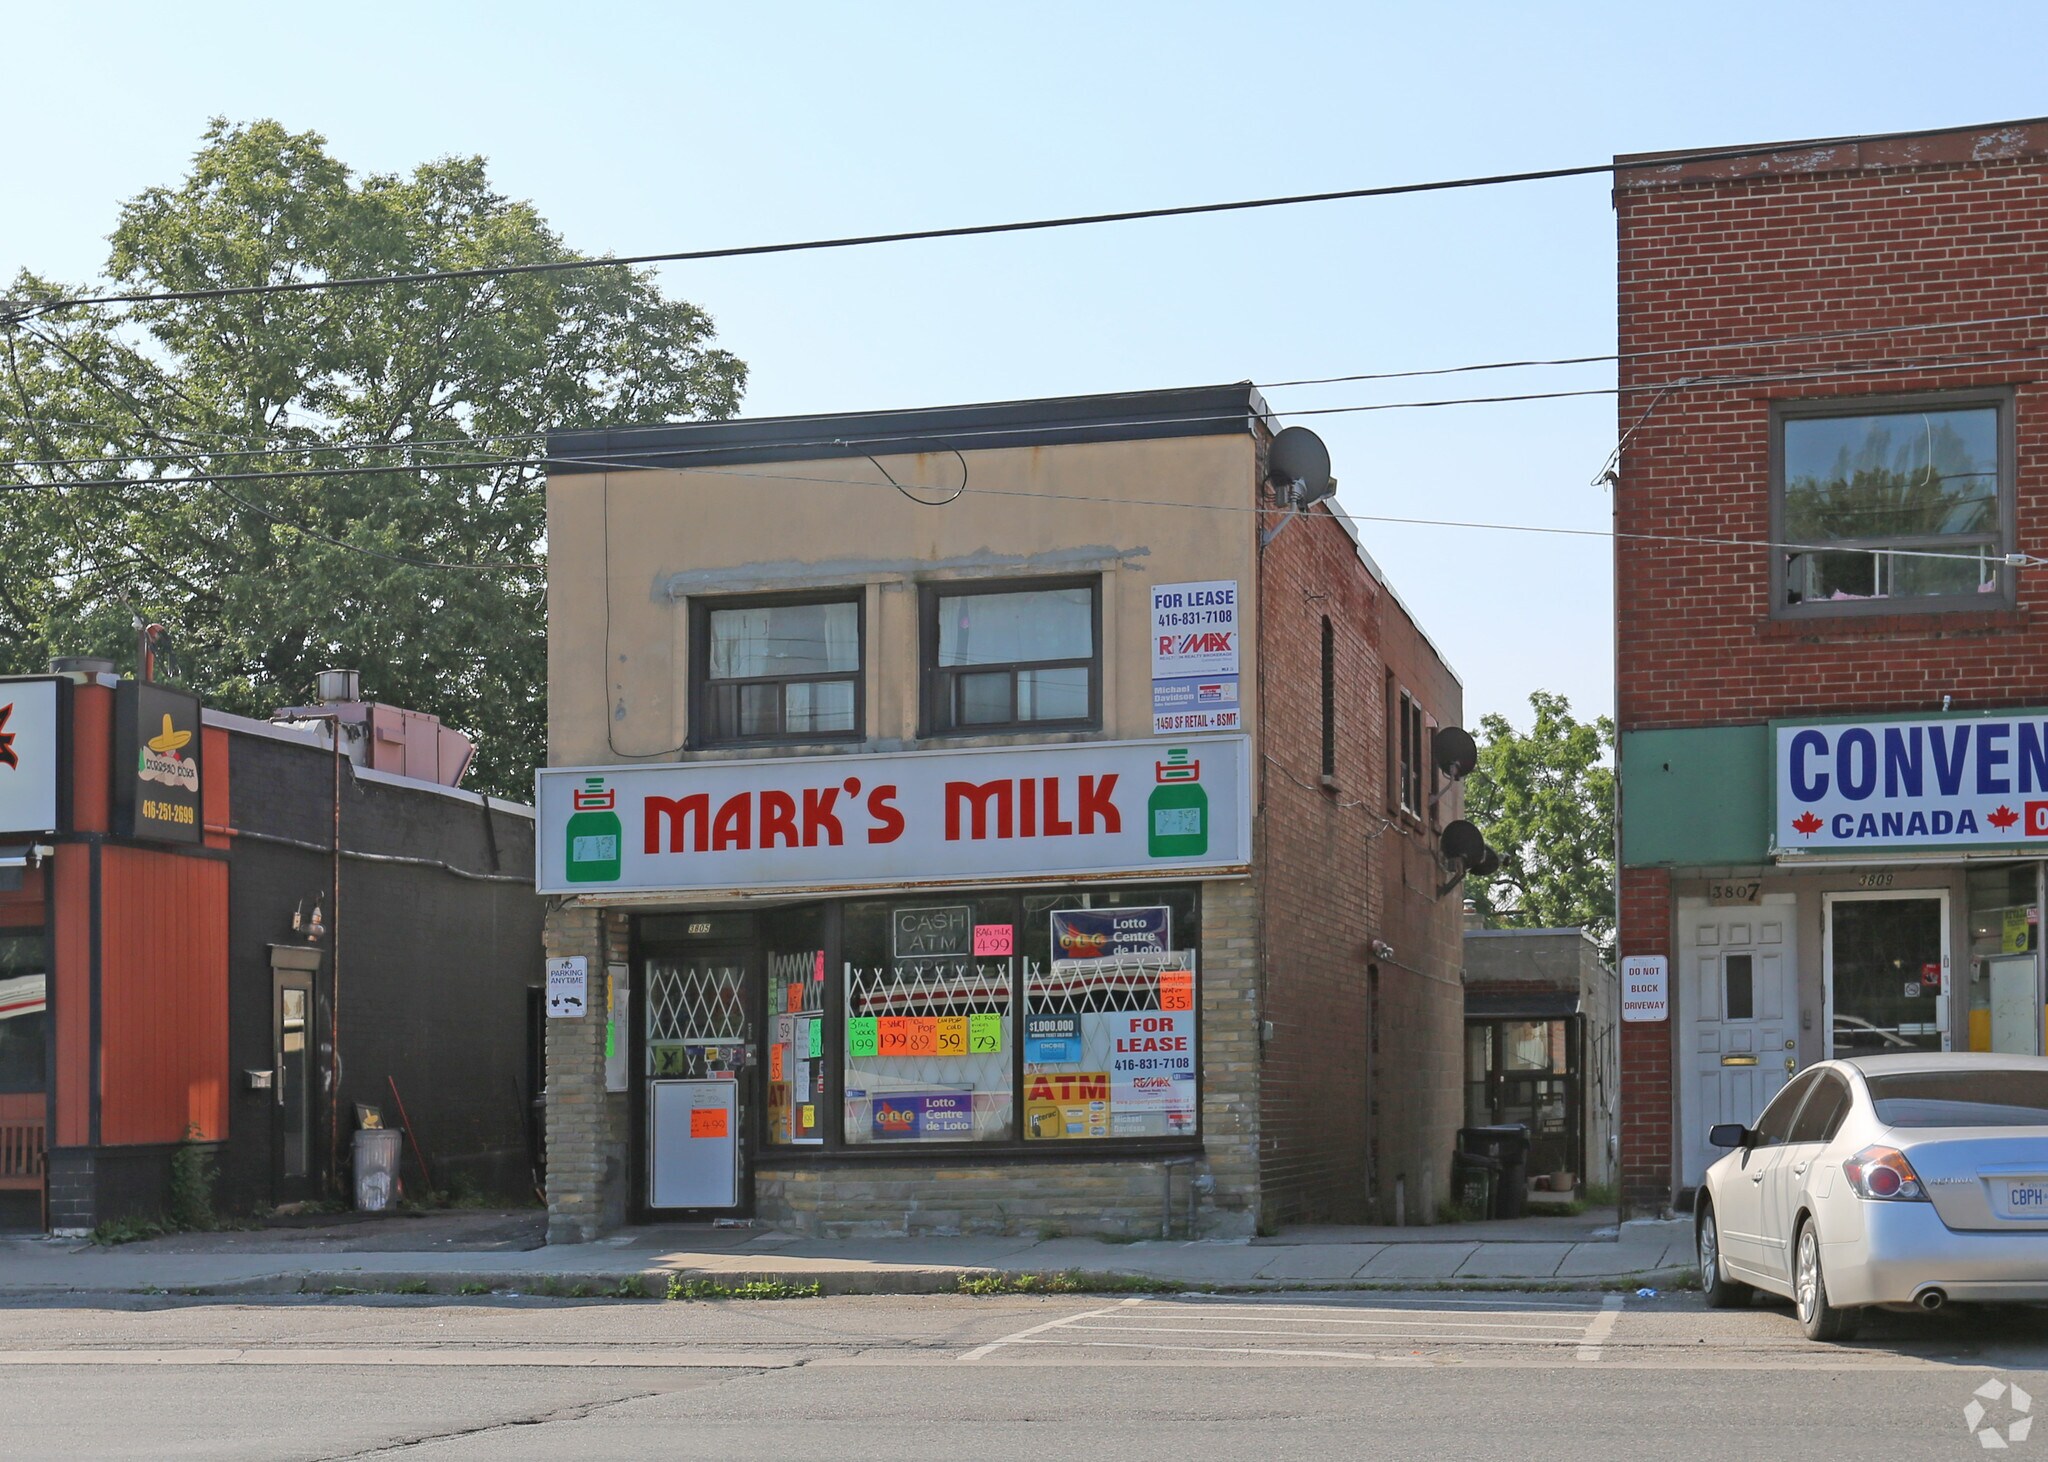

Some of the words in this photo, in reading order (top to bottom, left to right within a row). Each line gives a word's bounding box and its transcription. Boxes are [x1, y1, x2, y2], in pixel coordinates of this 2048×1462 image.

[1155, 594, 1182, 609] FOR
[1188, 590, 1234, 606] LEASE
[1159, 610, 1232, 626] 416-831-7108
[1160, 632, 1232, 655] R/MAX
[1154, 686, 1190, 694] Michael
[1154, 694, 1194, 702] Davidson
[1156, 717, 1172, 730] 1450
[1175, 716, 1184, 729] SF
[1185, 714, 1208, 728] RETAIL
[1217, 713, 1236, 726] BSMT
[1790, 722, 2048, 802] CONVEN
[644, 777, 905, 854] MARK'S
[945, 774, 1121, 841] MILK
[1832, 809, 1979, 838] CANADA
[1860, 875, 1893, 886] 3809
[1712, 883, 1760, 901] 3807
[901, 912, 964, 932] CASH
[1113, 919, 1147, 929] Lotto
[910, 934, 956, 951] ATM
[1113, 932, 1155, 942] Centre
[1113, 945, 1129, 955] de
[1134, 945, 1162, 955] Loto
[1625, 1001, 1664, 1009] DRIVEWAY
[850, 1018, 857, 1029] 3
[918, 1025, 936, 1033] POP
[1130, 1018, 1173, 1032] FOR
[852, 1039, 873, 1050] 199
[880, 1034, 906, 1048] 199
[1117, 1037, 1187, 1052] LEASE
[1115, 1058, 1189, 1070] 416-831-7108
[1028, 1075, 1106, 1100] ATM
[1134, 1077, 1170, 1088] RE/MAX
[926, 1099, 956, 1107] Lotto
[878, 1111, 912, 1121] OLG
[926, 1110, 963, 1119] Centre
[926, 1121, 939, 1130] de
[944, 1121, 968, 1130] Loto
[2012, 1189, 2042, 1205] CBPH
